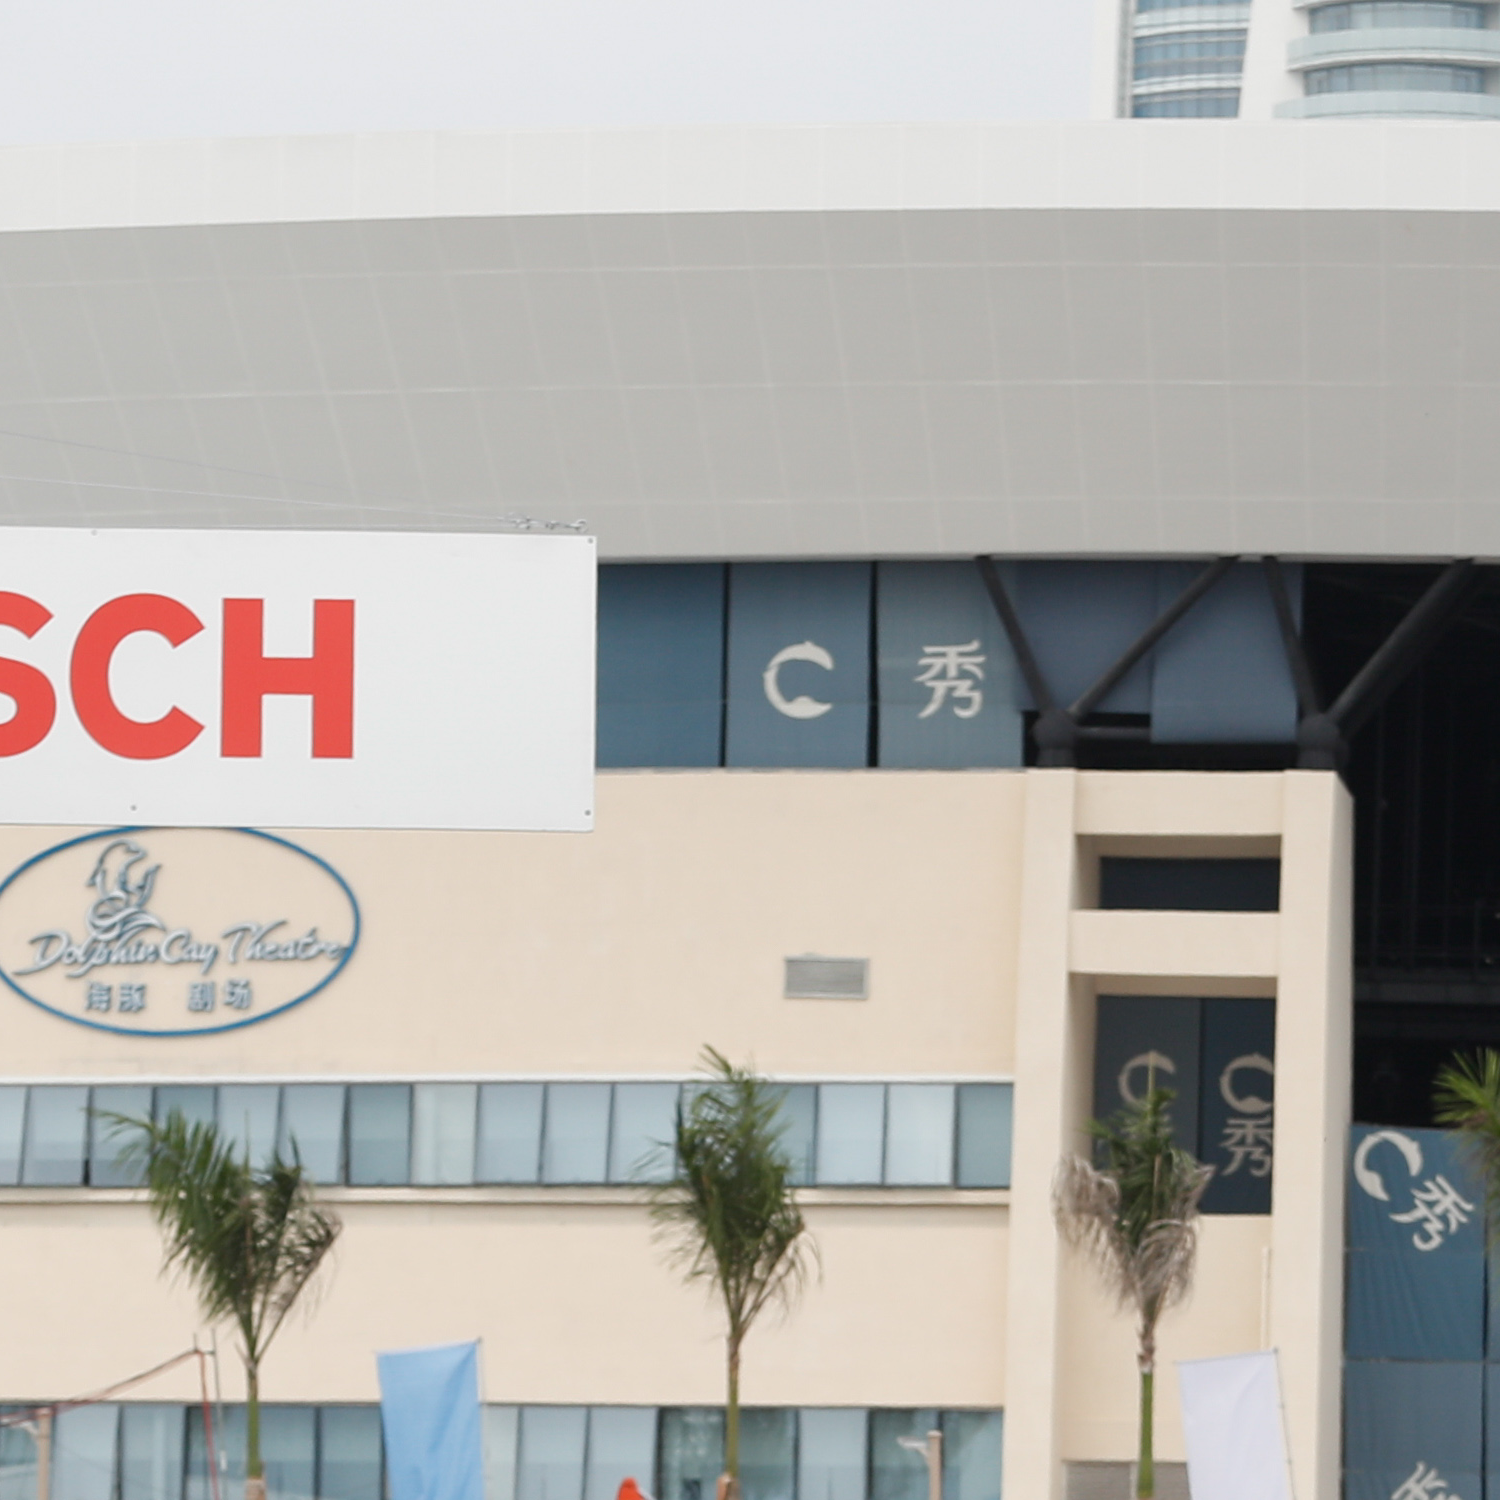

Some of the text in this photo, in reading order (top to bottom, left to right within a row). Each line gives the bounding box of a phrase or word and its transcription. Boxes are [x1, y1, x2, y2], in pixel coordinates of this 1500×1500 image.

[914, 639, 987, 719] 秀
[12, 918, 352, 979] Dolphin Cay Theatre
[1389, 1174, 1475, 1253] 秀
